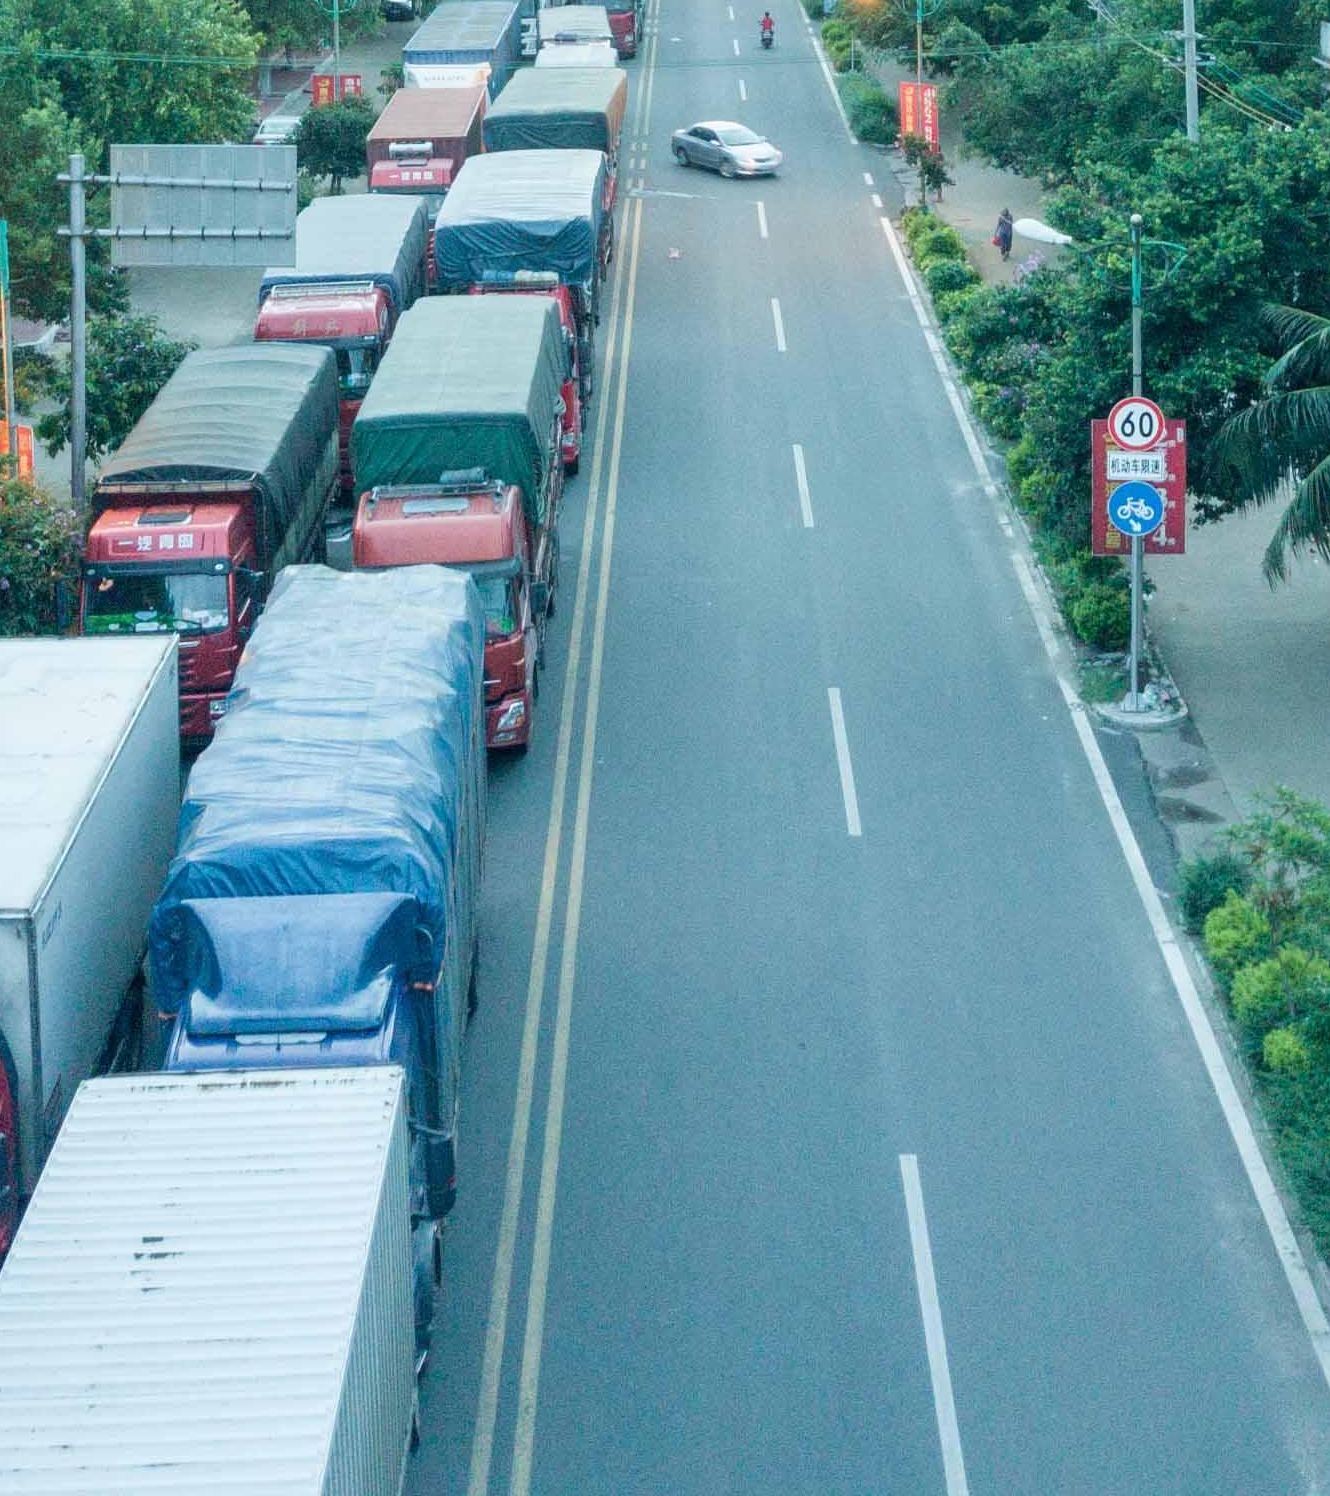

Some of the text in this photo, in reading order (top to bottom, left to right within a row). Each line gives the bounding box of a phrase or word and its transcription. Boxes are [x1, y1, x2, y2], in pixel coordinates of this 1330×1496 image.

[1121, 411, 1153, 438] 60
[1111, 457, 1161, 474] 机动车限速
